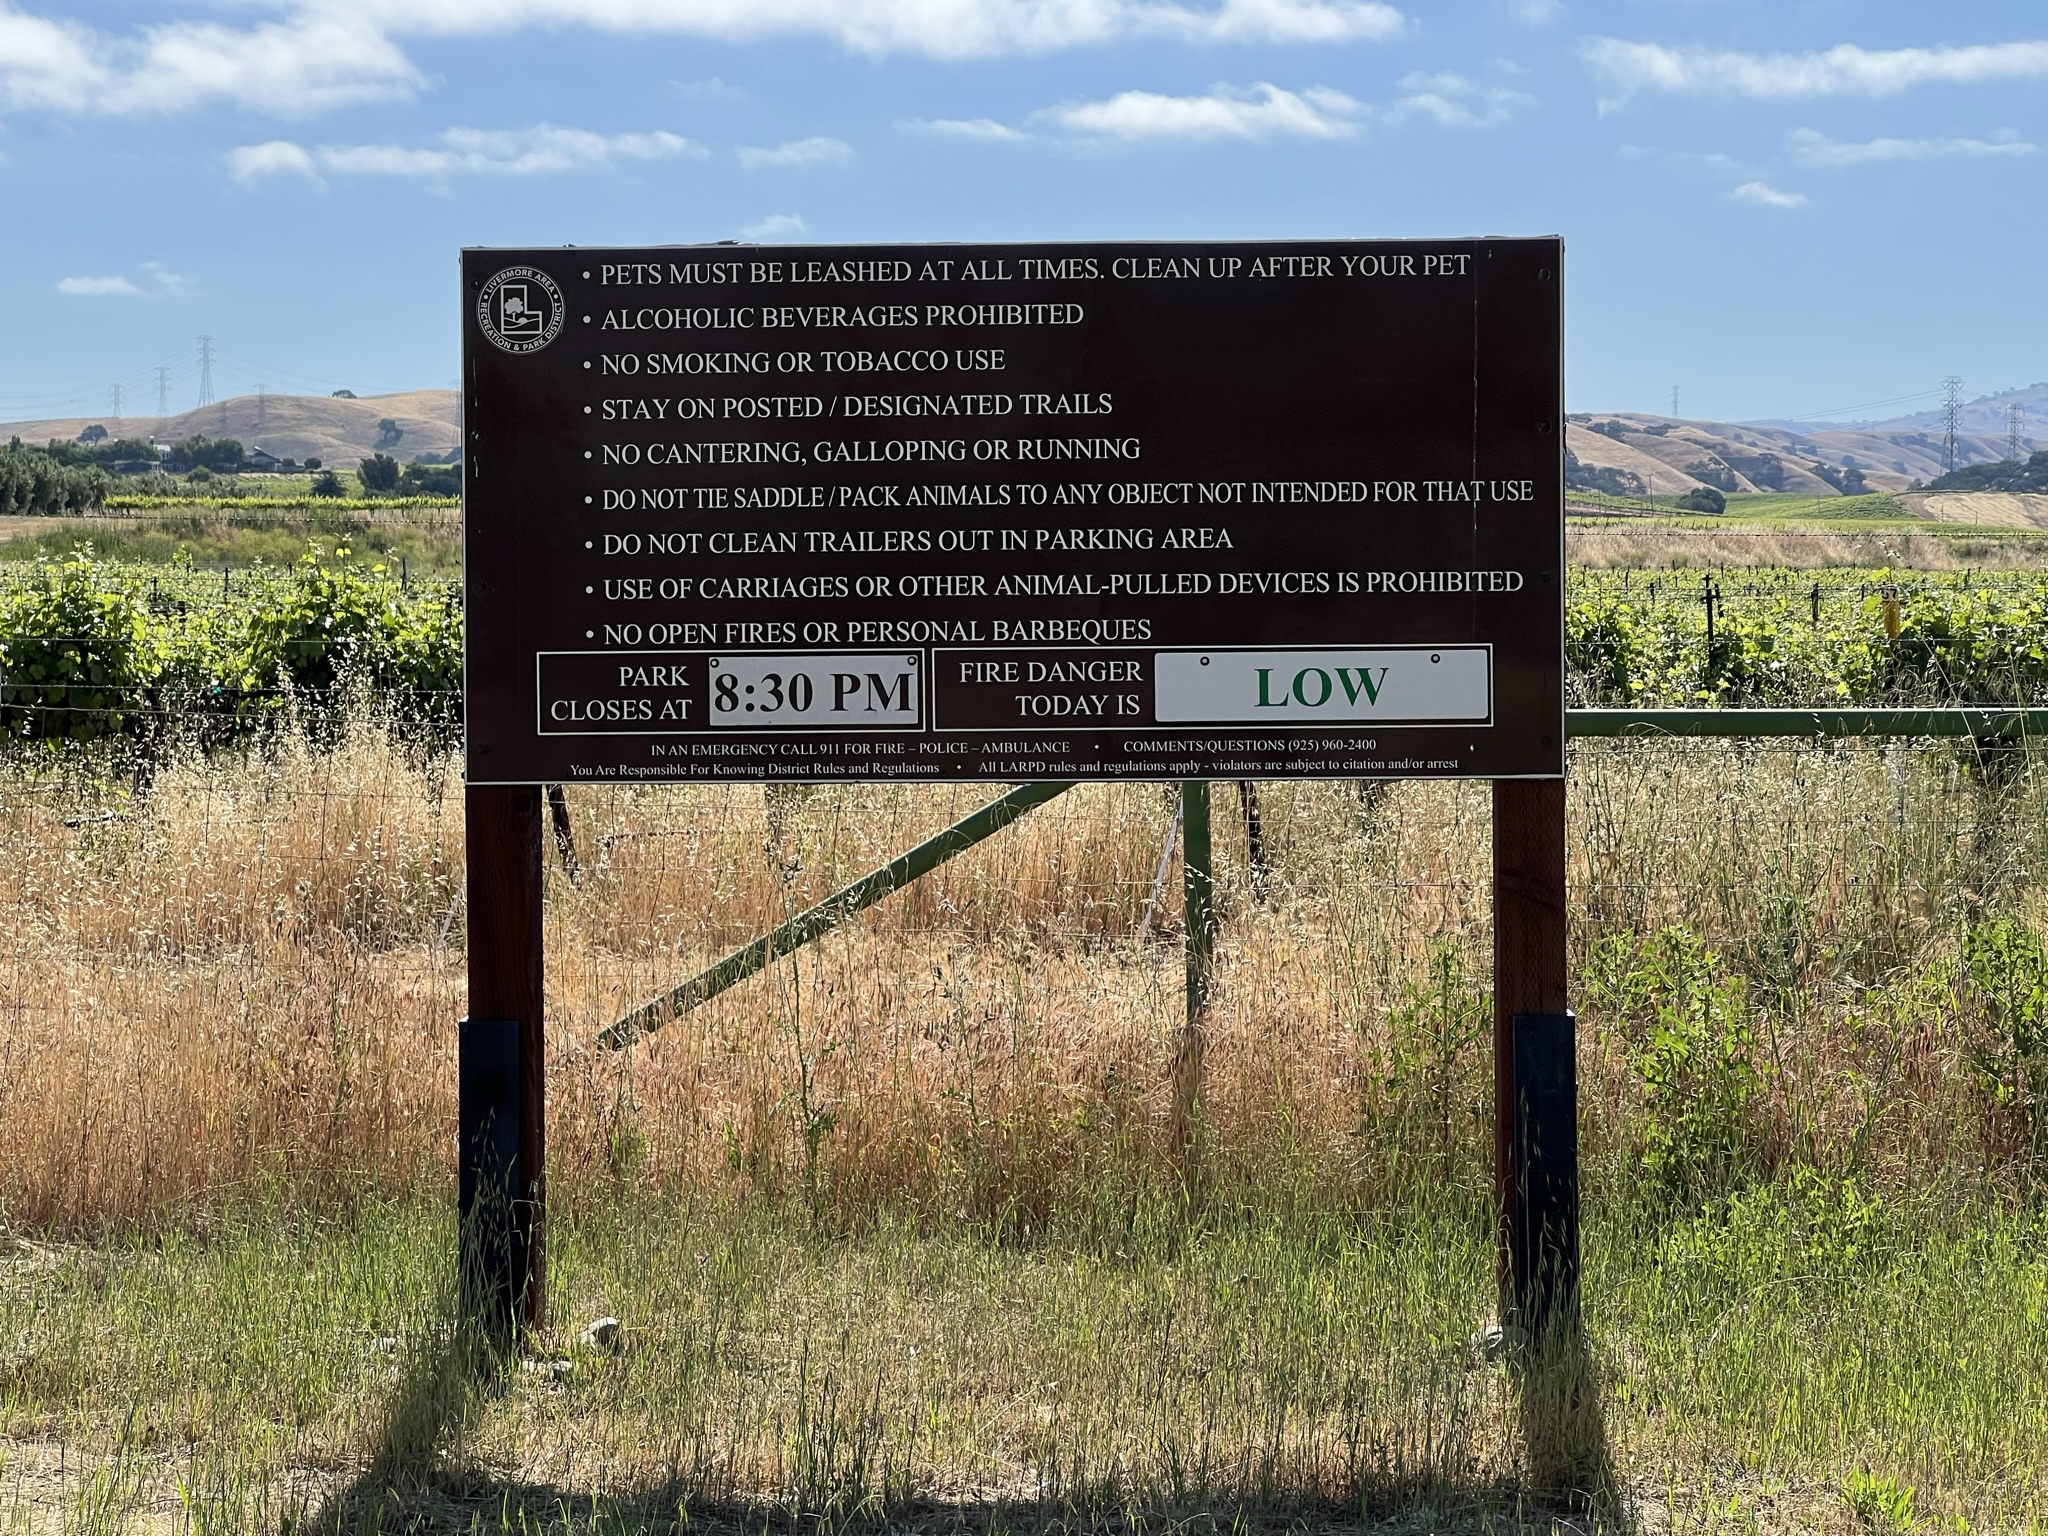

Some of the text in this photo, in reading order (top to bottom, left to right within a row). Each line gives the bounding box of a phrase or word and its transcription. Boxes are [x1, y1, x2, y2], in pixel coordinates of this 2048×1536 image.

[485, 269, 556, 293] LIVERMORE AREA
[600, 254, 1471, 285] PETS MUST BE LEASHED AT ALL TIMES. CLEAN UP AFTER YOUR PET
[480, 302, 512, 349] RECREATION
[522, 338, 546, 351] PARK
[544, 302, 562, 339] DISTRICT
[600, 303, 1084, 330] ALCOHOLIC BEVERAGES PROHIBITED
[600, 349, 1006, 375] NO SMOKING OR TOBACCO USE
[602, 398, 671, 420] STAY
[677, 398, 715, 419] ON
[723, 396, 823, 419] POSTED
[843, 394, 1013, 417] DESIGNATED
[1019, 393, 1113, 415] TRAILS
[601, 437, 1141, 467] NO CANTERING, GALLOPING OR RUNNING
[603, 488, 636, 510] DO
[640, 488, 689, 510] NOT
[693, 487, 729, 509] TIE
[734, 485, 825, 509] SADDLE
[905, 484, 1011, 506] ANIMALS
[1015, 483, 1048, 505] TO
[1052, 483, 1103, 505] ANY
[1108, 482, 1194, 505] OBJECT
[1197, 482, 1247, 504] NOT
[1251, 481, 1368, 503] INTENDED
[1373, 480, 1419, 502] FOR
[1422, 480, 1485, 503] THAT
[1490, 480, 1534, 502] USE
[603, 527, 1234, 555] DO NOT CLEAN TRAILERS OUT IN PARKING AREA
[604, 570, 1524, 600] USE OF CARRIAGES OR OTHER ANIMAL-PULLED DEVICES IS PROHIBITED
[603, 618, 1152, 646] NO OPEN FIRES OR PERSONAL BARBEQUES
[619, 665, 690, 687] PARK
[959, 661, 1144, 683] FIRE DANGER
[714, 673, 915, 713] 8:30 PM
[1254, 667, 1390, 707] LOW
[550, 699, 693, 721] CLOSES AT
[1015, 694, 1140, 716] TODAY IS
[651, 744, 665, 756] IN
[668, 744, 688, 756] AN
[692, 743, 778, 756] EMERGENCY
[780, 743, 818, 755] CALL
[819, 743, 840, 755] 911
[844, 743, 872, 755] FOR
[875, 742, 906, 755] FIRE
[919, 742, 969, 754] POLICE
[981, 741, 1071, 754] AMBULANCE
[1123, 739, 1377, 754] COMMENTS/QUESTIONS (925) 960-2400
[570, 761, 940, 778] You Are Responsible For Knowing District Rules and Regulations
[978, 761, 996, 773] All
[1000, 761, 1046, 773] LARPD
[1048, 760, 1077, 772] rules
[1079, 760, 1101, 772] and
[1103, 759, 1167, 775] regulations
[1169, 759, 1201, 774] apply
[1212, 758, 1262, 771] violators
[1264, 761, 1283, 770] are
[1285, 758, 1325, 773] subject
[1328, 760, 1340, 770] to
[1342, 757, 1385, 770] citation
[1387, 757, 1425, 769] and/or
[1426, 759, 1459, 769] arrest
